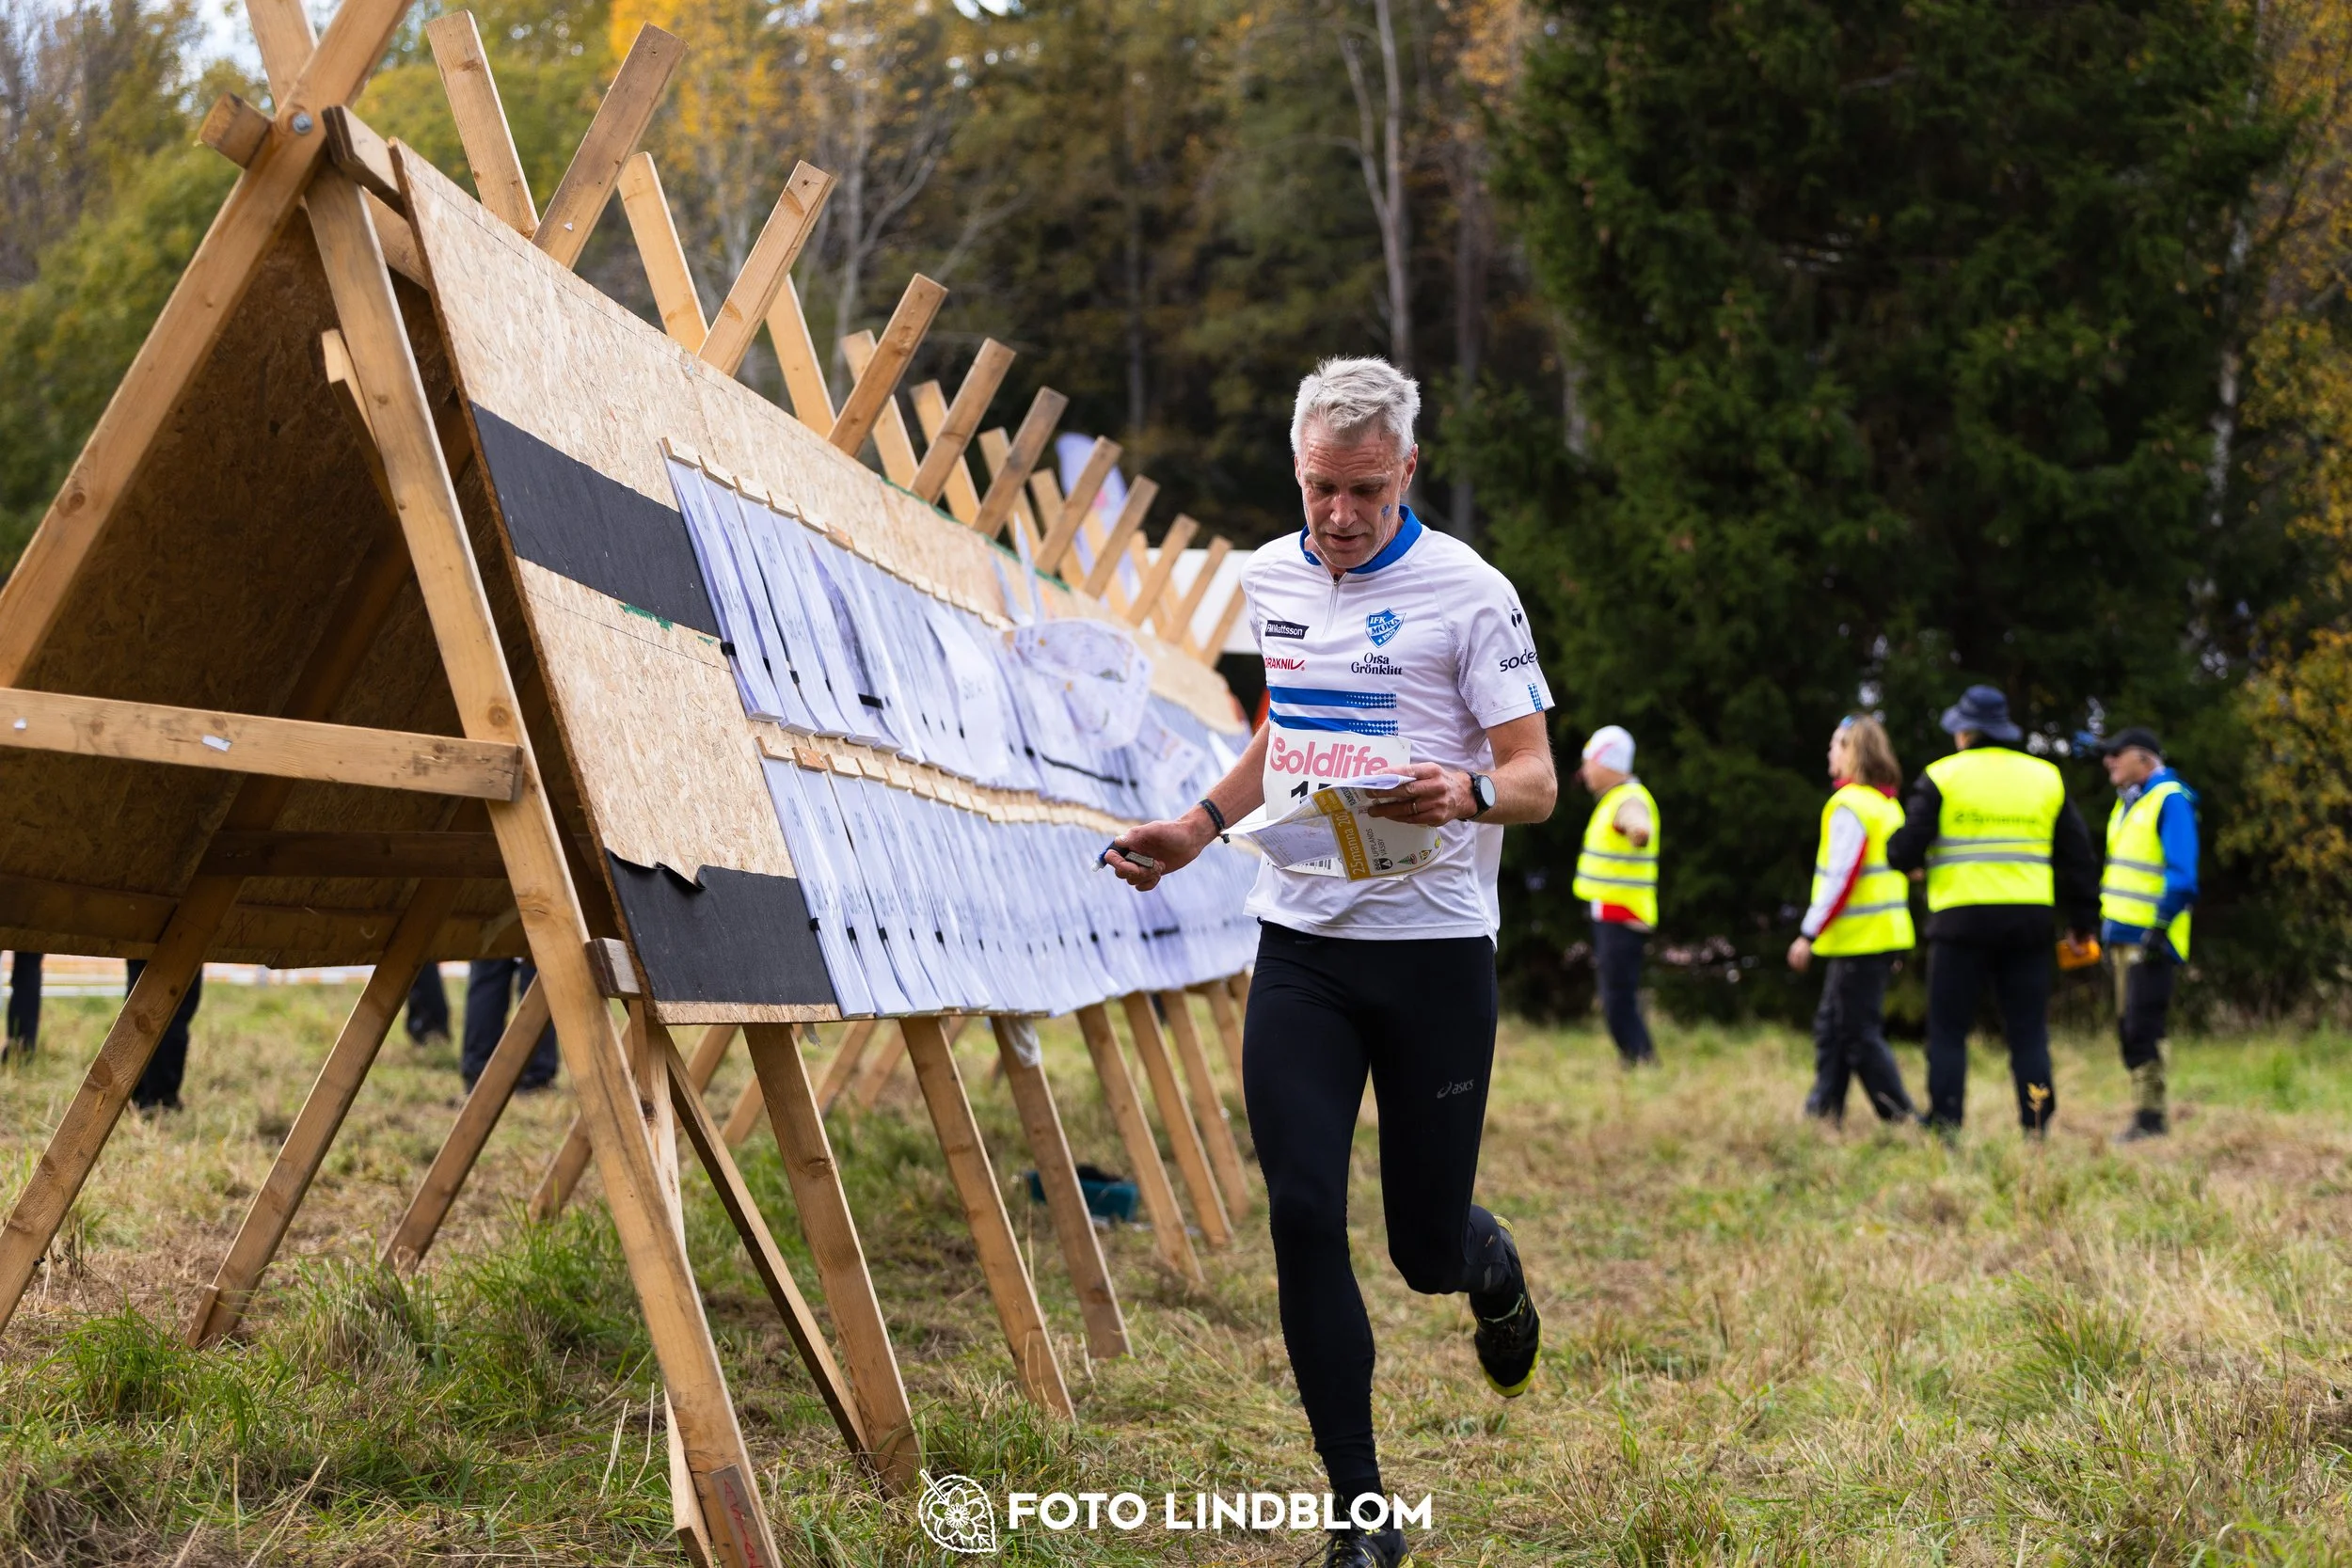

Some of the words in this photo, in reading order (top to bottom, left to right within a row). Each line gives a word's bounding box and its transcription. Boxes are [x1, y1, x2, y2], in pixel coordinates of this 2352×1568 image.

[1369, 616, 1386, 625] IFK
[1371, 618, 1399, 635] MORA
[1364, 652, 1390, 665] Orsa
[1351, 661, 1403, 675] Grönklitt
[1270, 736, 1389, 779] Goldlife
[1365, 828, 1380, 858] UPPLANDS
